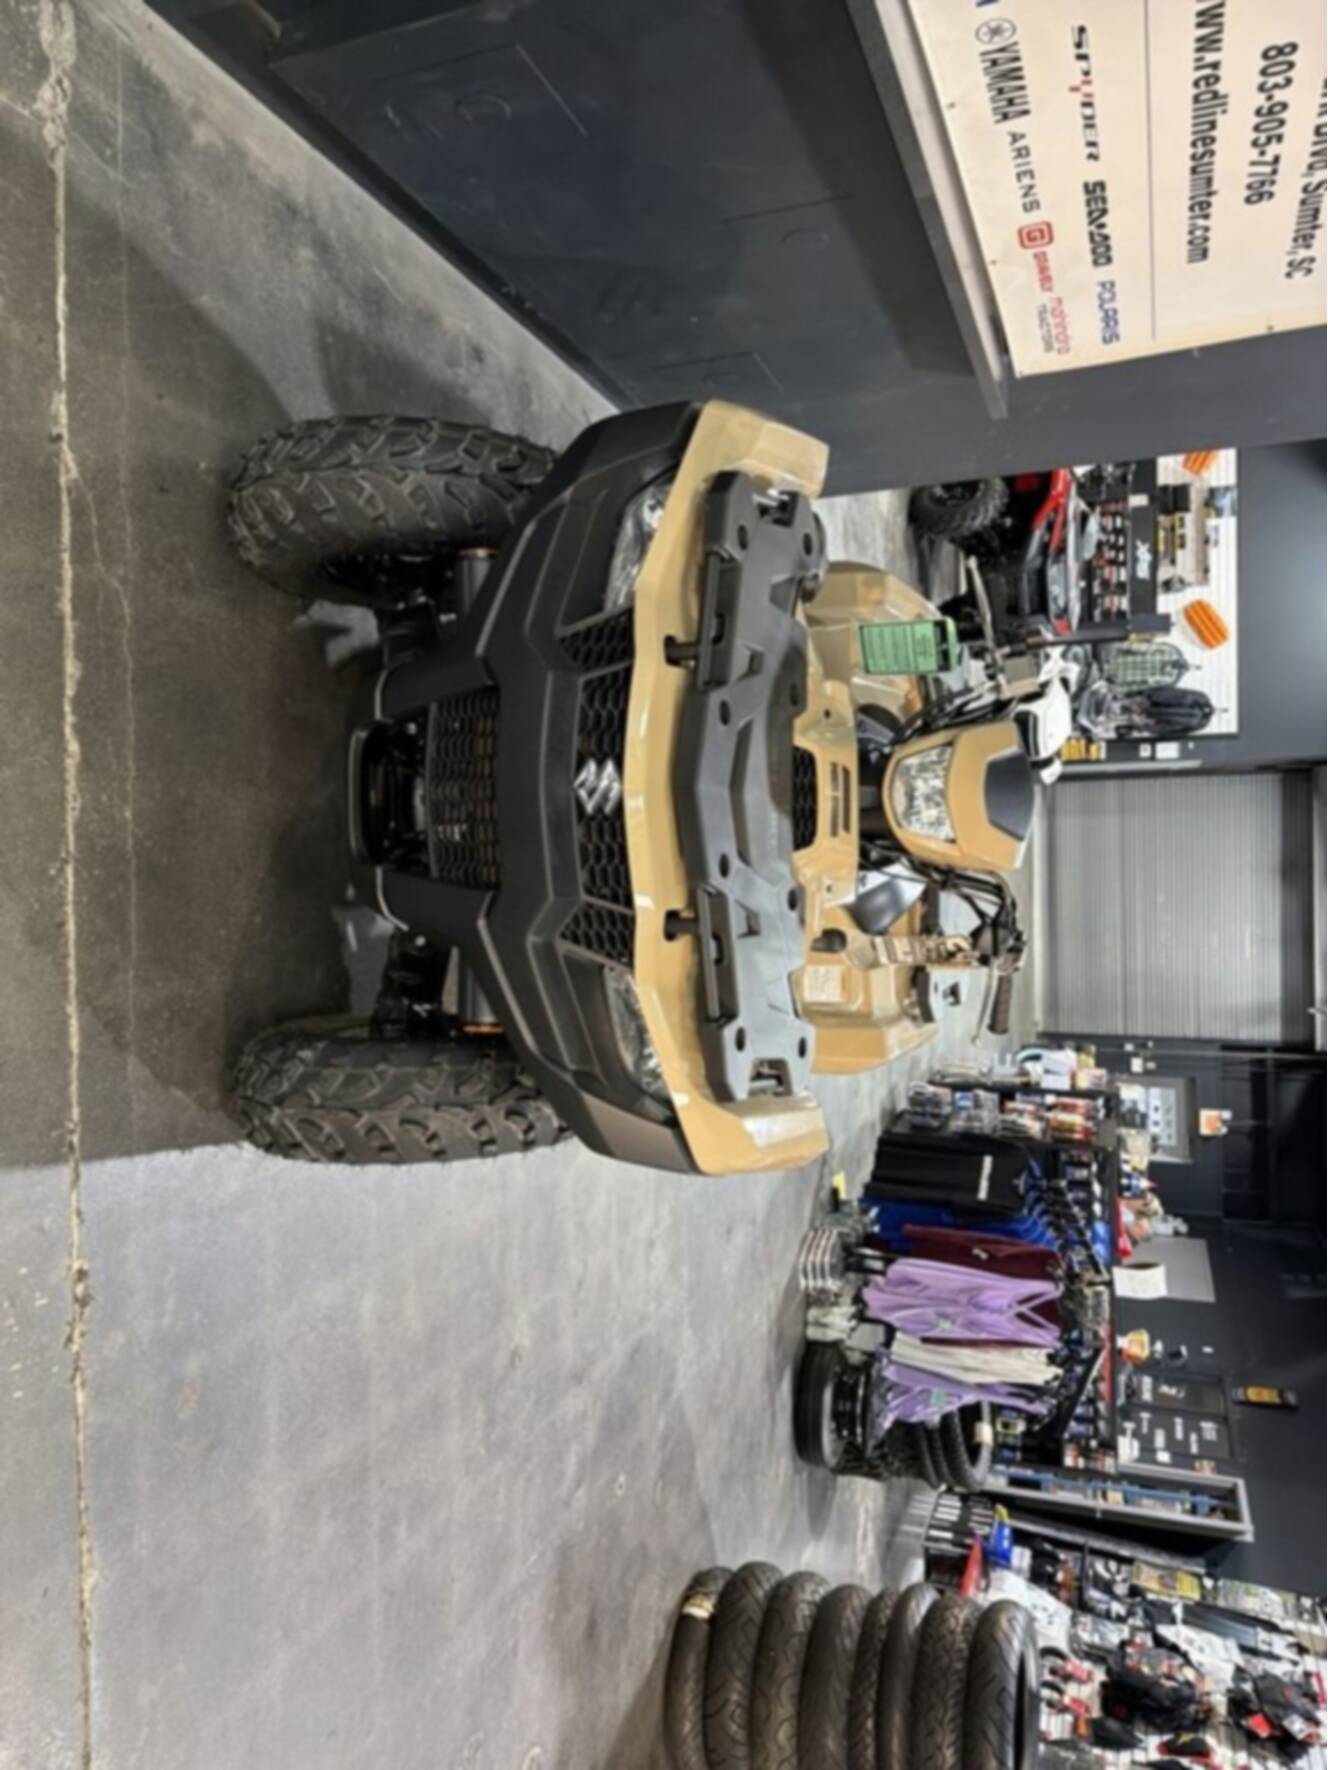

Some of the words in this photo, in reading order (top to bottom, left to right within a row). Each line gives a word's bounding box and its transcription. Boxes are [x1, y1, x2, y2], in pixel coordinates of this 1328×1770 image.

[978, 41, 1031, 124] YAMAHA
[1068, 24, 1100, 163] SPYDER
[1244, 42, 1299, 205] 803-905-7766
[1007, 131, 1041, 214] ARIENS
[1187, 0, 1230, 264] ww.redlinesumter.com
[1286, 179, 1328, 255] Sumter,
[1285, 256, 1317, 279] SC
[1097, 280, 1120, 345] POLARIS
